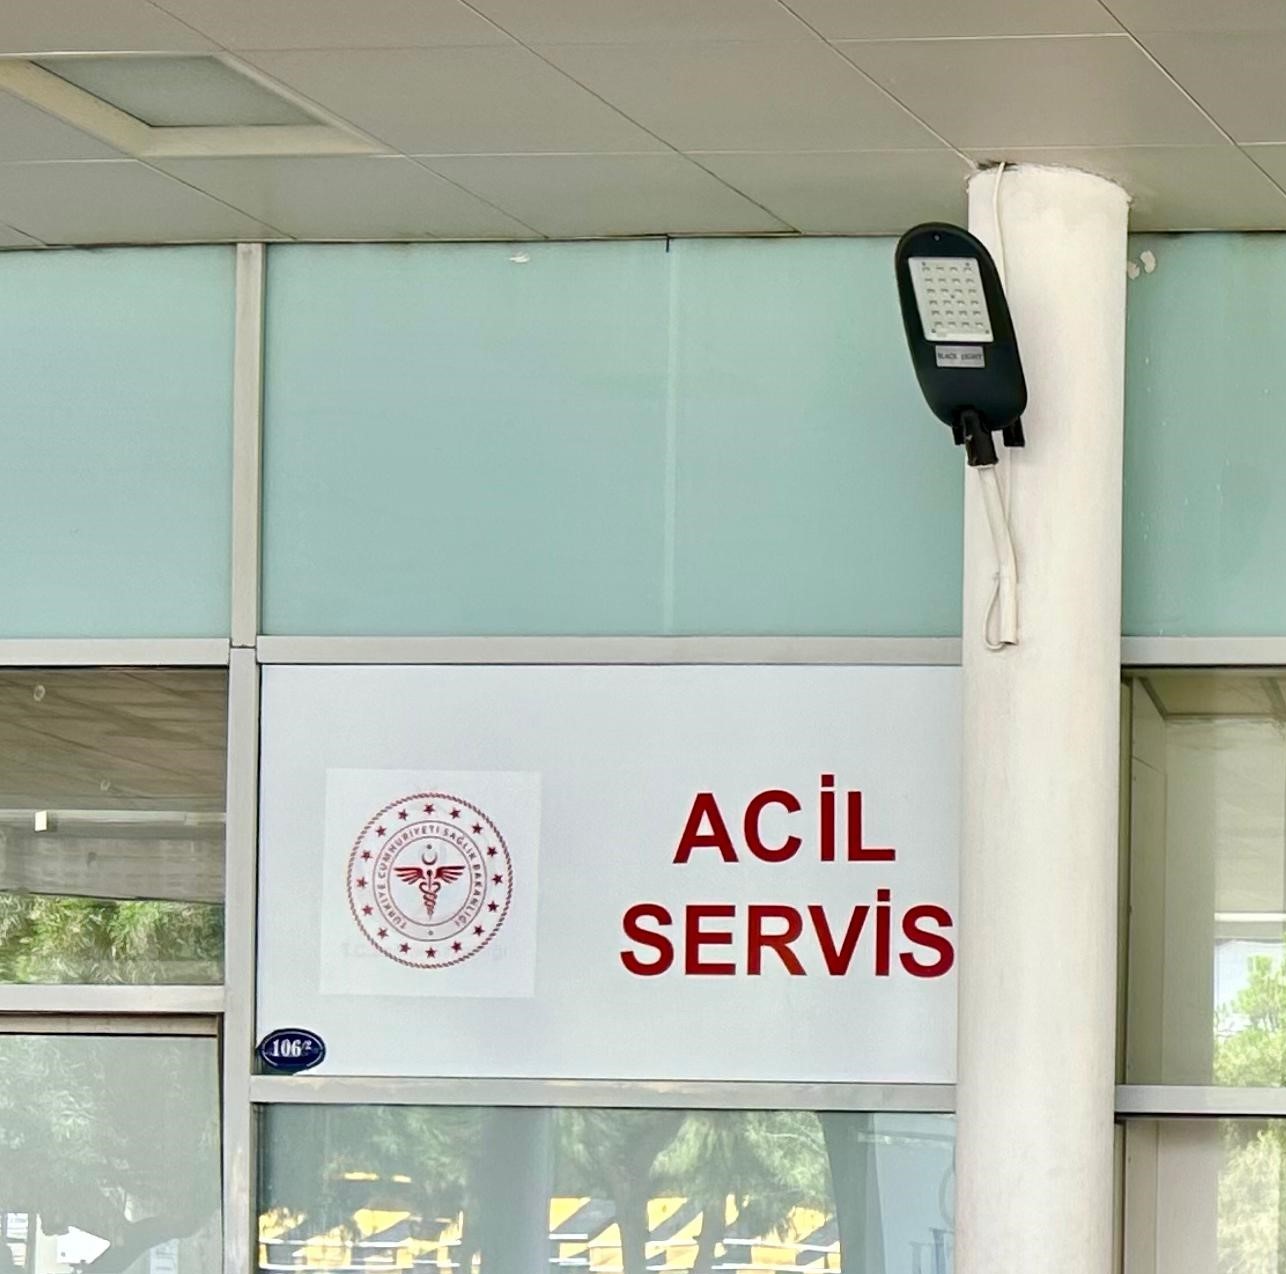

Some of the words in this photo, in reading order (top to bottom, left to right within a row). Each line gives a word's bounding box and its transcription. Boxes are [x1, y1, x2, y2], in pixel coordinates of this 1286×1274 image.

[443, 827, 477, 861] SAĞLIK
[675, 774, 895, 863] ACİL
[379, 824, 441, 880] CUMHURİYETİ
[378, 883, 408, 930] TÜRKİYE
[455, 864, 482, 928] BAKANLIĞI
[621, 889, 954, 978] SERVİS
